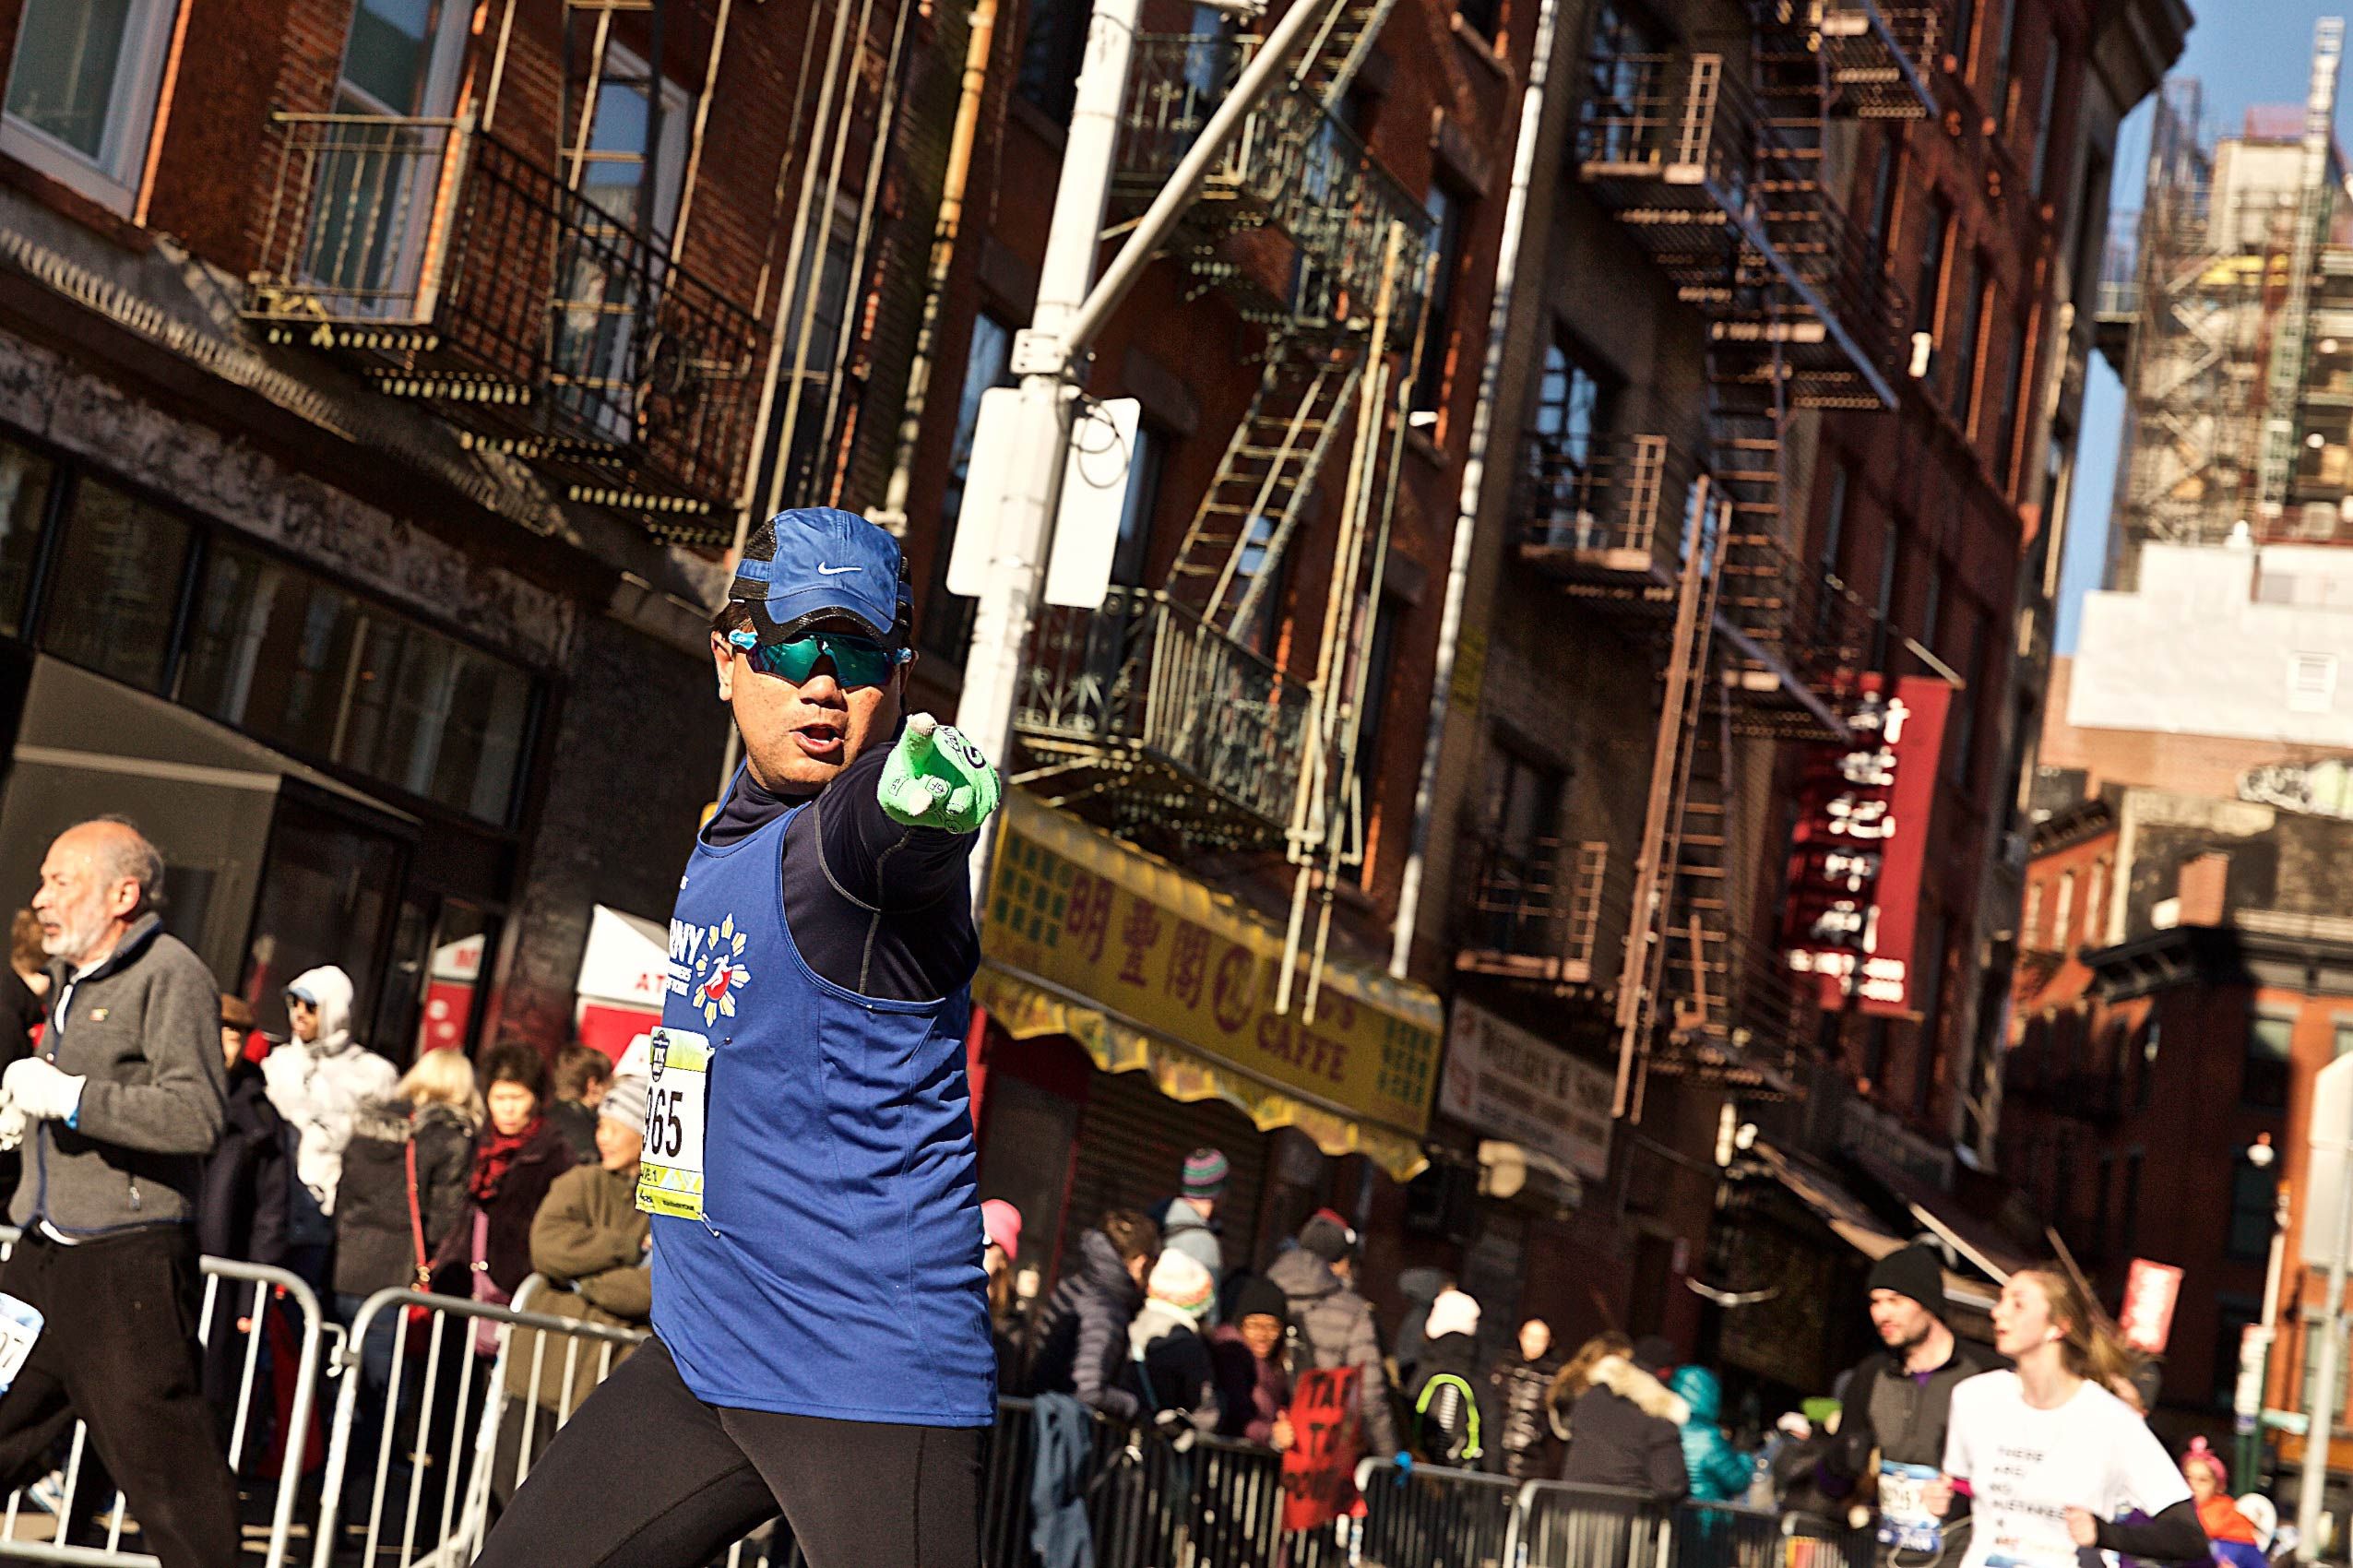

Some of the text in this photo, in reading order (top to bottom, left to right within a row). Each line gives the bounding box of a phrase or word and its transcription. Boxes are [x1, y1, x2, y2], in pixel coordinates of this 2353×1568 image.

[635, 973, 666, 993] AT
[1256, 1013, 1349, 1084] CAFFE
[642, 1086, 683, 1158] 965
